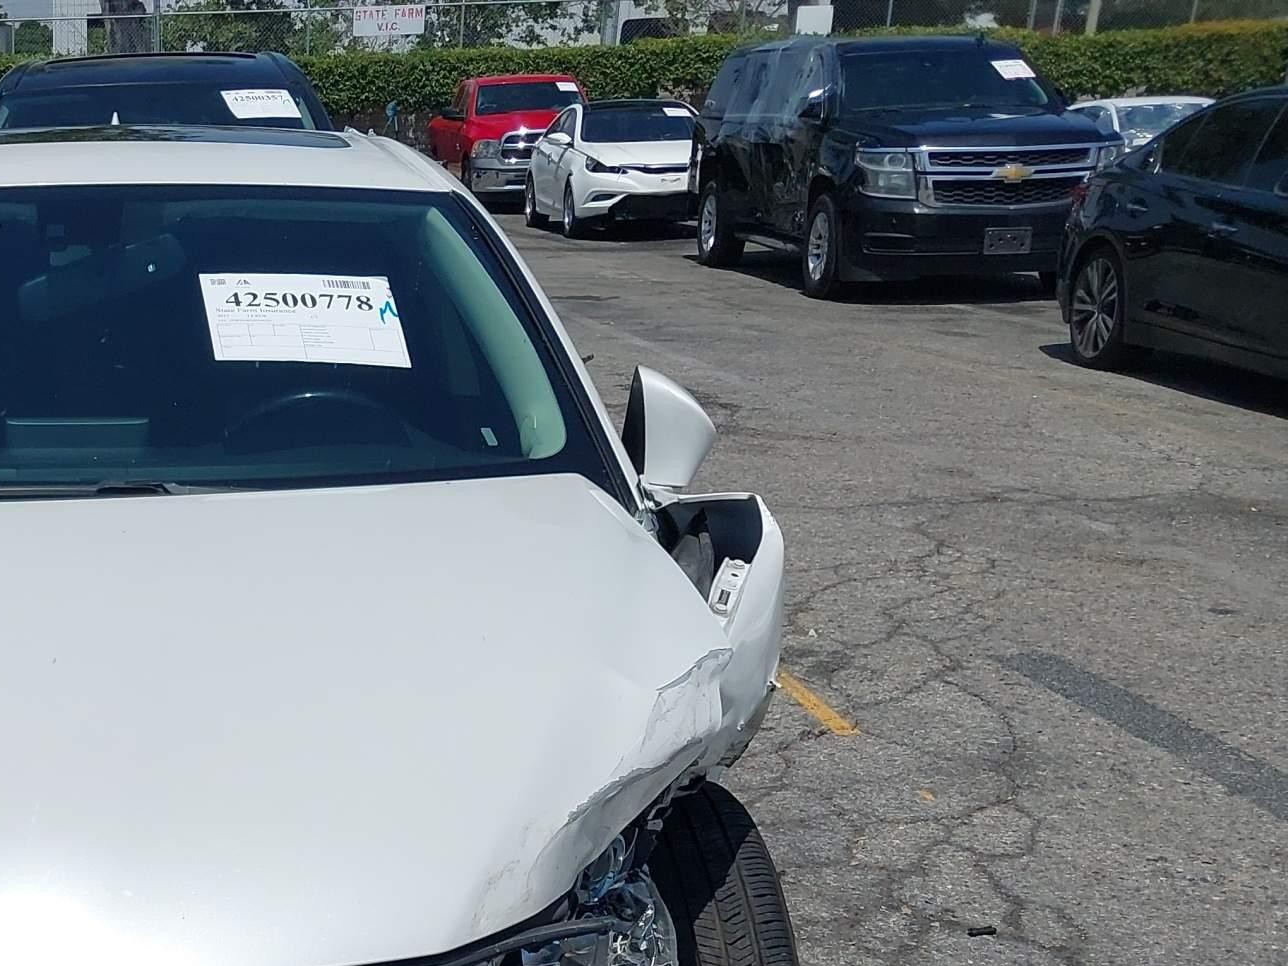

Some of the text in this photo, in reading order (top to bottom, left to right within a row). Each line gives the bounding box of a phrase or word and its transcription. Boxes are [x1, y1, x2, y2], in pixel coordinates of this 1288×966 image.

[355, 7, 423, 21] STATE FARM
[377, 22, 400, 32] V.I.C.
[225, 292, 374, 311] 42500778
